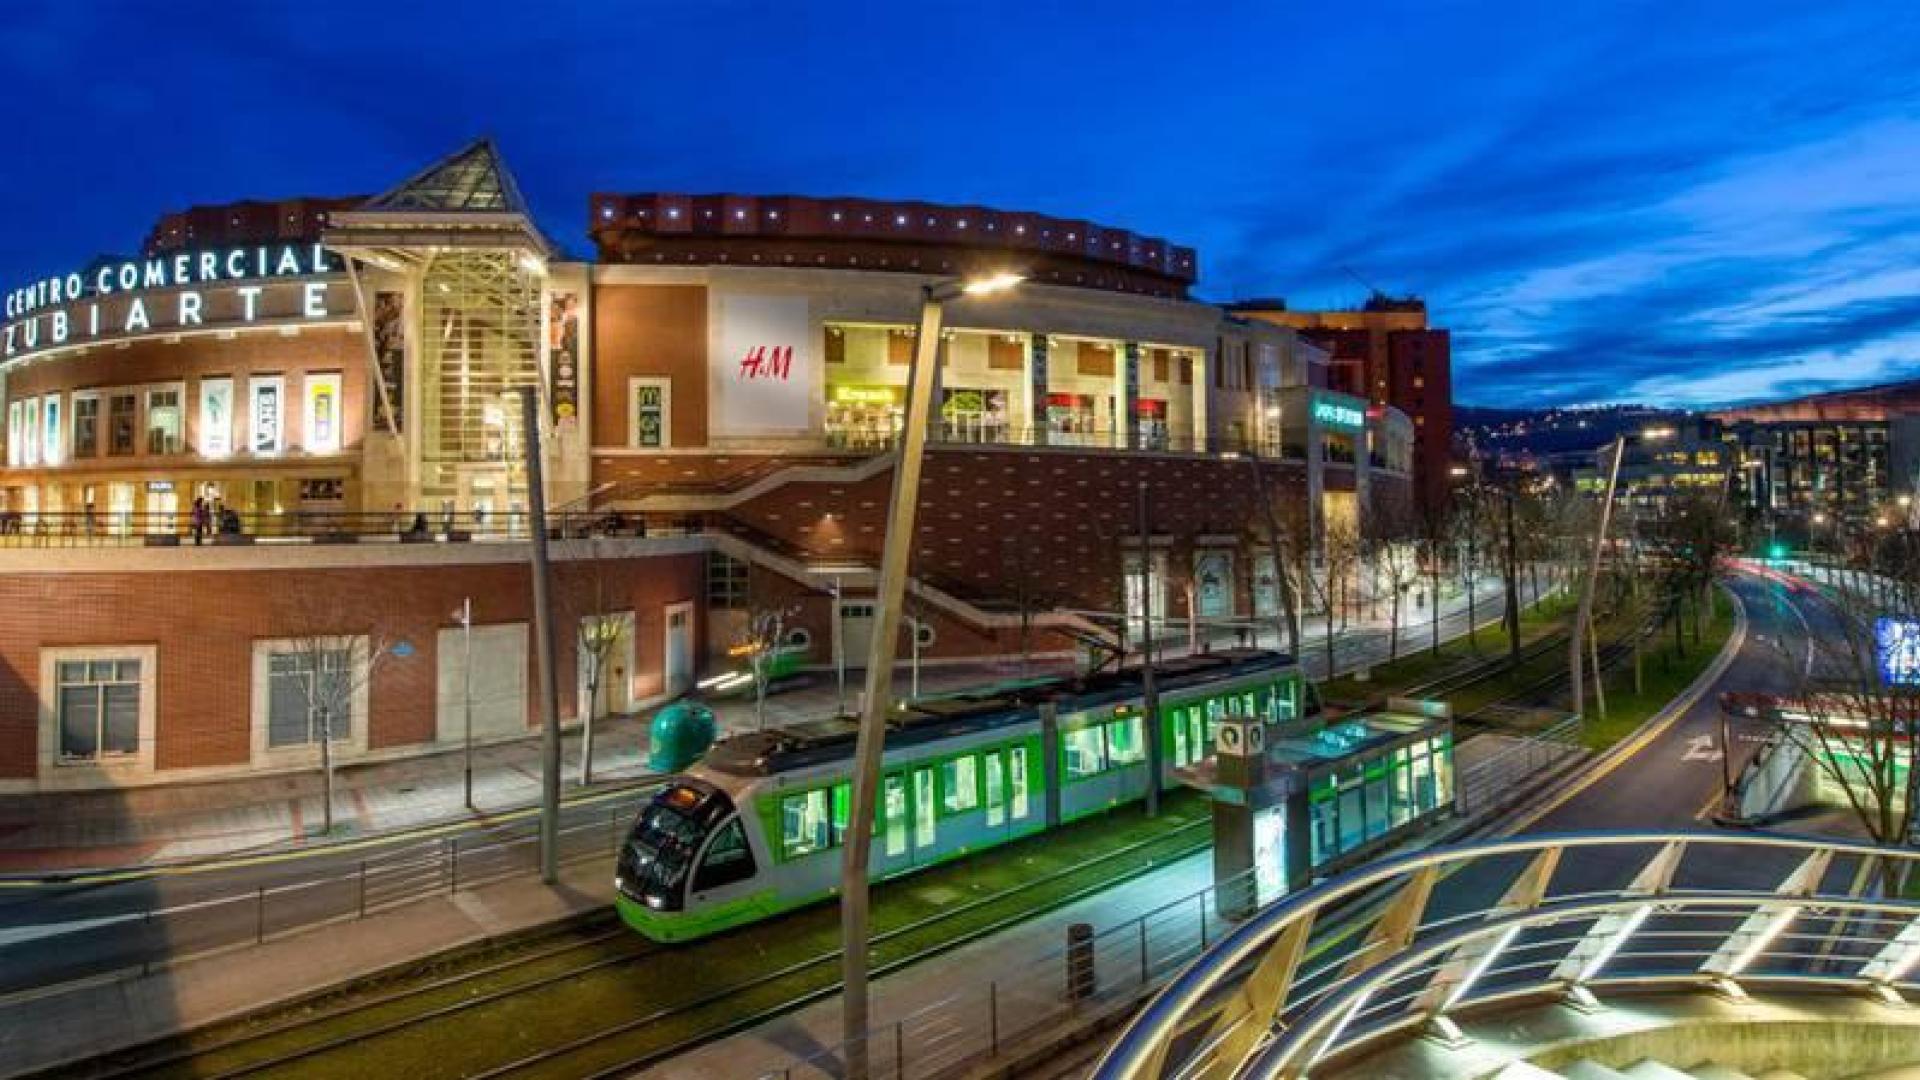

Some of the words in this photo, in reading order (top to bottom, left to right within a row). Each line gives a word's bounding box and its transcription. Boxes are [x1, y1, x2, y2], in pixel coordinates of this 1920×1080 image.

[6, 272, 82, 318] CENTRO
[98, 244, 330, 294] COMERCIAL
[3, 283, 328, 354] ZUBIARTE
[740, 345, 792, 381] H&M
